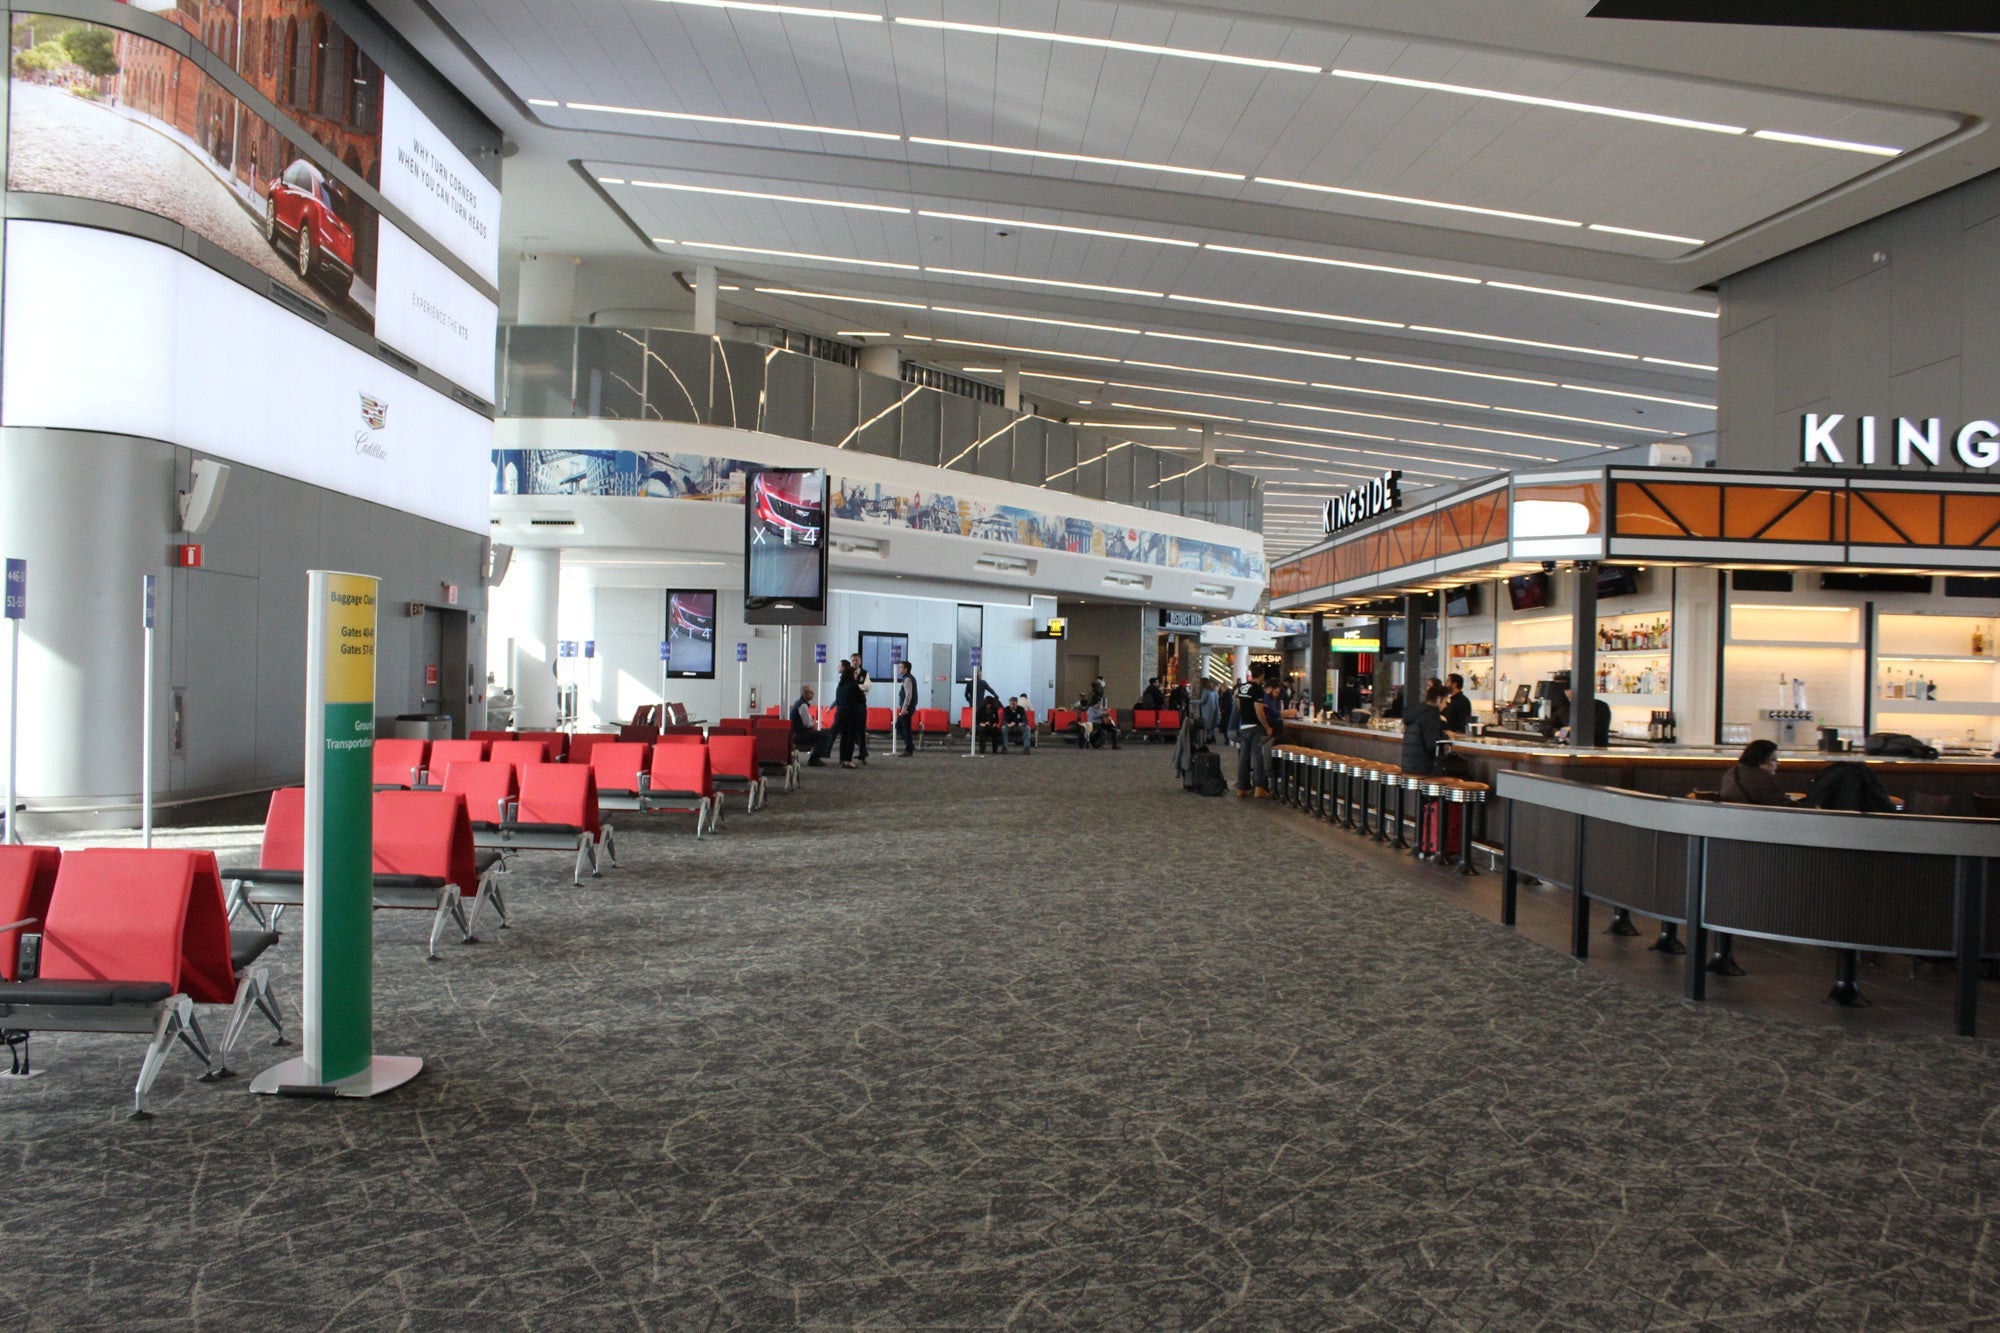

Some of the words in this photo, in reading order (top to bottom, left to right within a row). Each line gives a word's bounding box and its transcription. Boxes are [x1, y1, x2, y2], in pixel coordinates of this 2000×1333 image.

[413, 137, 429, 163] WHY
[431, 154, 448, 182] TURN
[449, 173, 477, 209] CORNERS
[398, 146, 419, 178] WHEN
[421, 168, 435, 192] YOU
[436, 182, 450, 206] CAN
[451, 196, 467, 222] TURN
[468, 211, 487, 239] HEADS
[412, 292, 447, 326] EXPERIENCE
[447, 316, 458, 333] THE
[354, 430, 388, 462] Cadillac
[1322, 470, 1393, 533] KINGSIDE
[330, 591, 362, 606] Baggage
[341, 626, 362, 638] Gates
[341, 643, 362, 655] Gates
